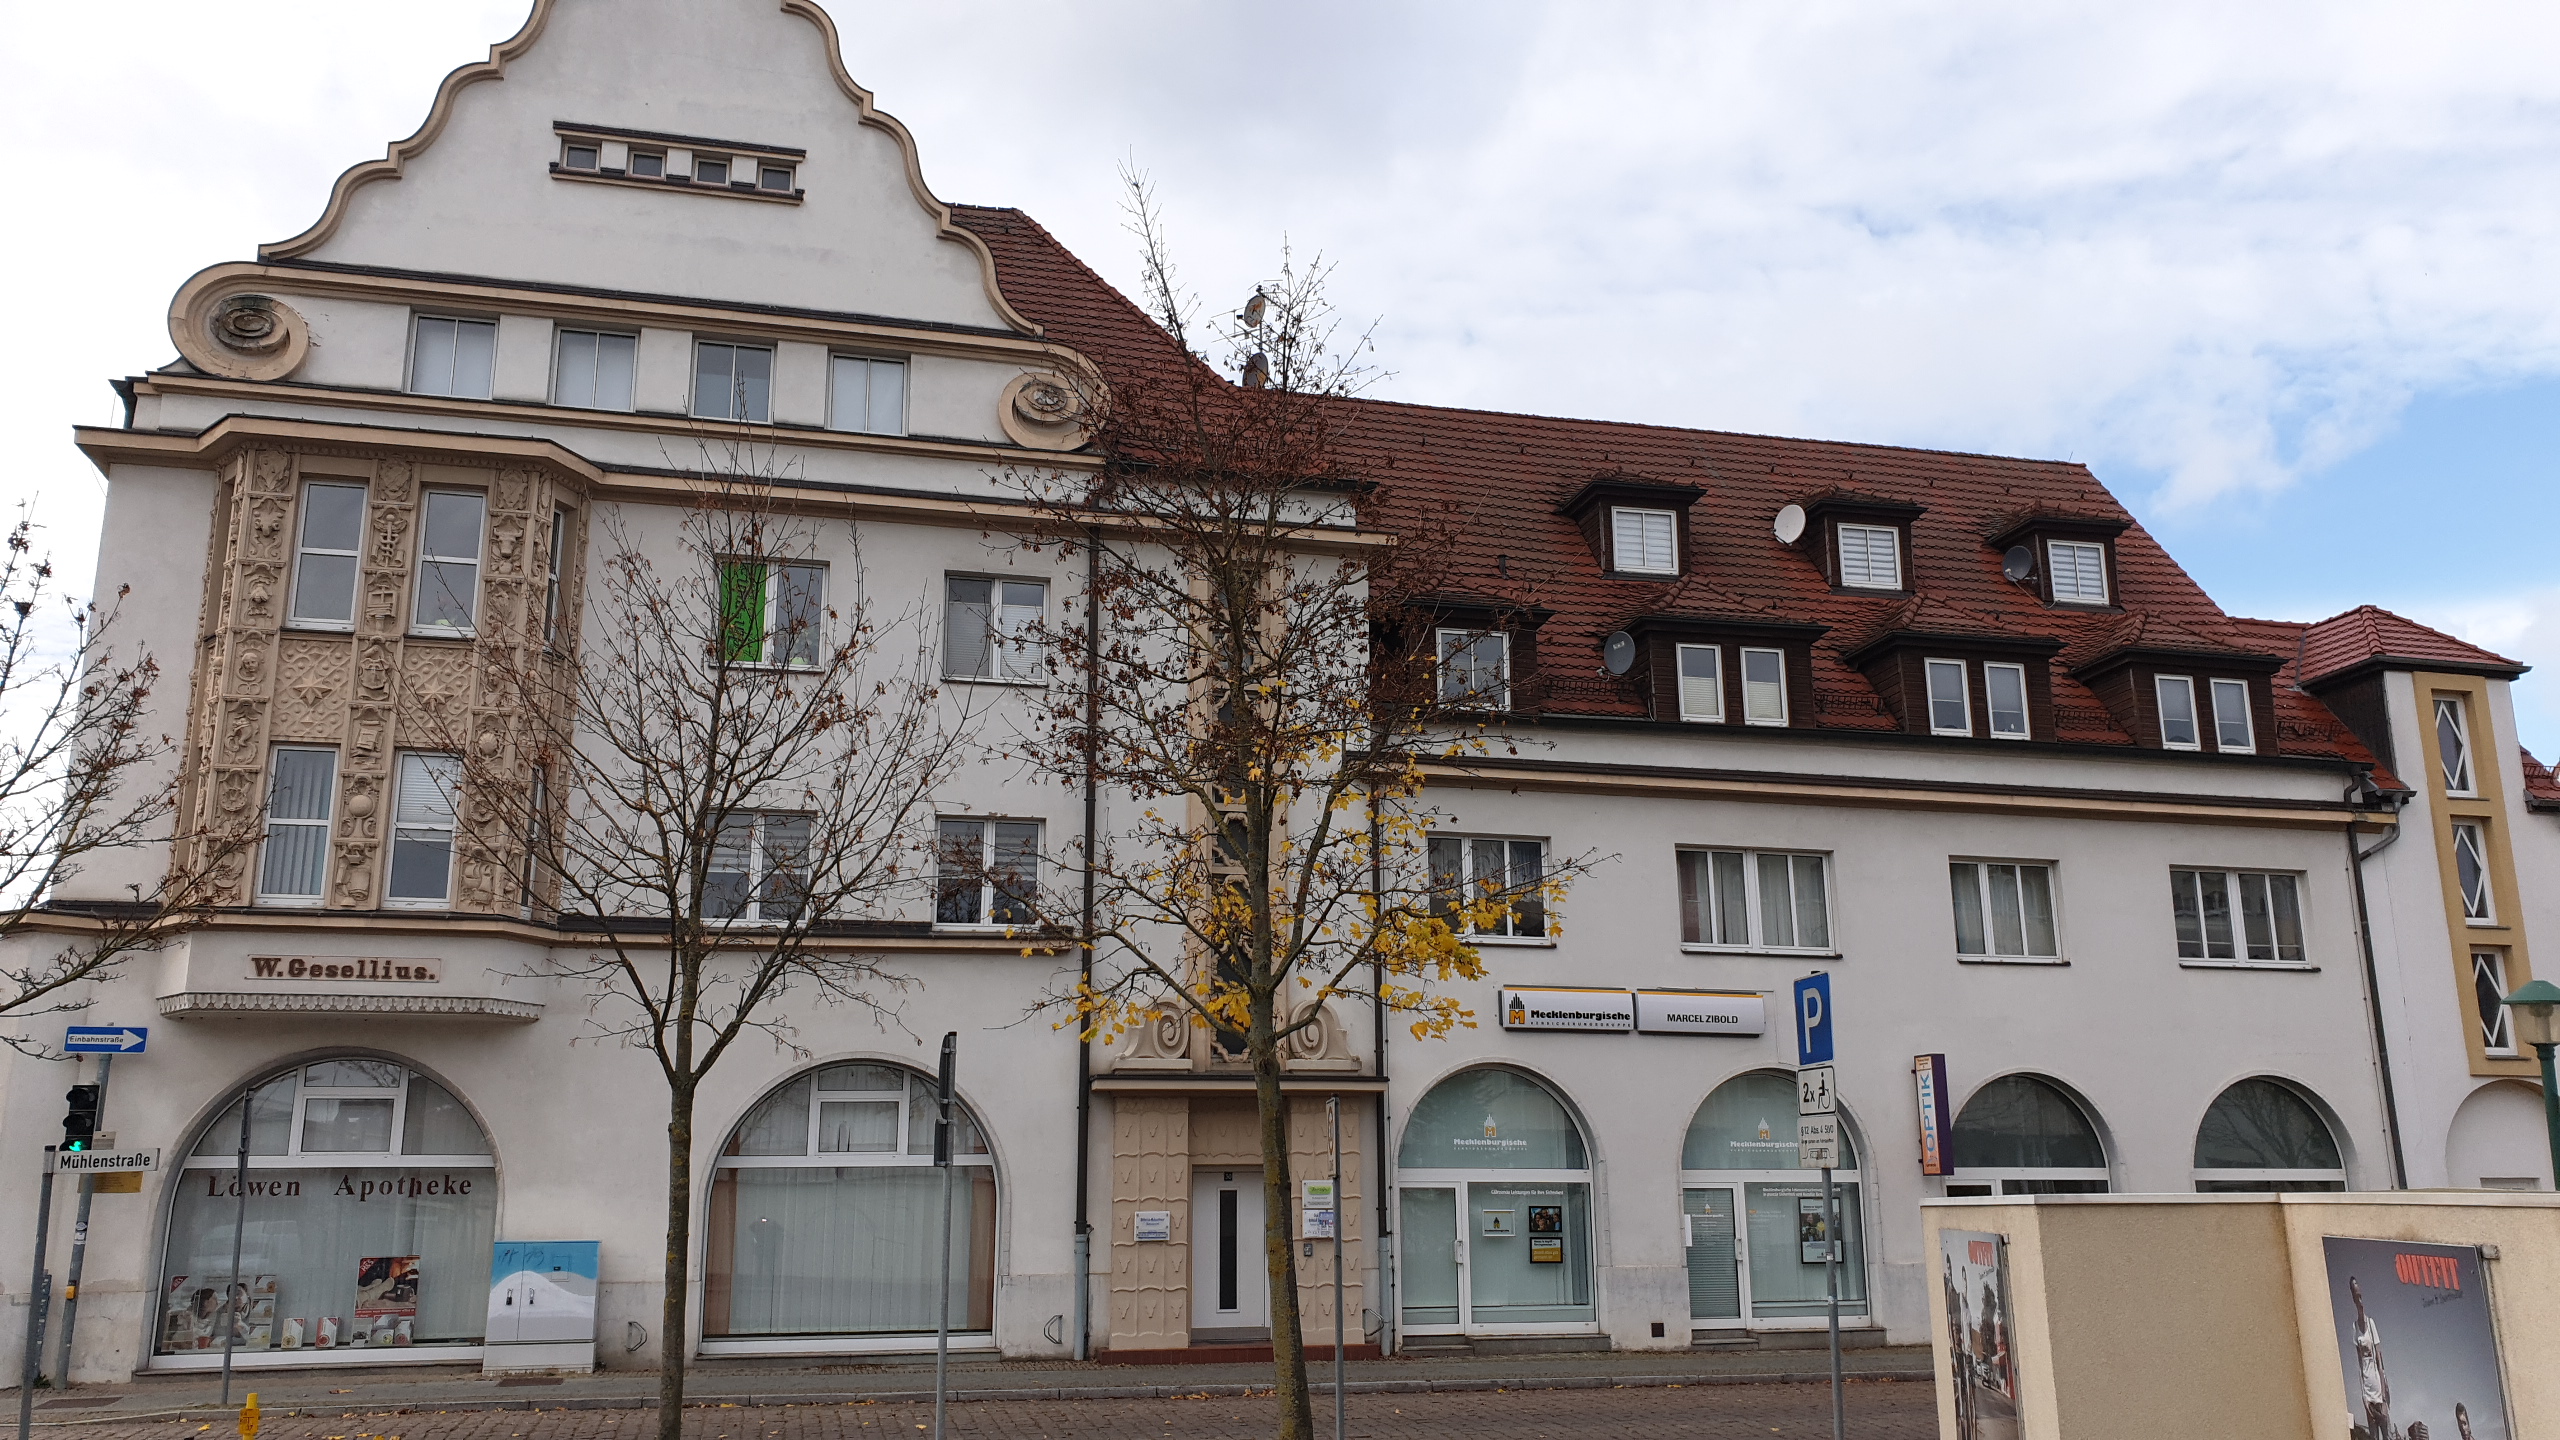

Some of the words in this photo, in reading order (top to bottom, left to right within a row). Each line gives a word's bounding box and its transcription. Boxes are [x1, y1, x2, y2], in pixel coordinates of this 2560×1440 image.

[1530, 1010, 1631, 1022] Mecklenburgische
[1667, 1013, 1704, 1023] MARCEL
[1705, 1014, 1739, 1024] ZIBOLD
[1803, 987, 1823, 1054] P
[69, 1035, 124, 1044] Einbahnstraße
[1920, 1071, 1936, 1152] OPTIK
[1453, 1138, 1528, 1147] Mecklenburgische
[60, 1152, 151, 1169] Mühlenstraße
[333, 1175, 472, 1202] Apotheke
[2395, 1253, 2460, 1291] OUTFIT
